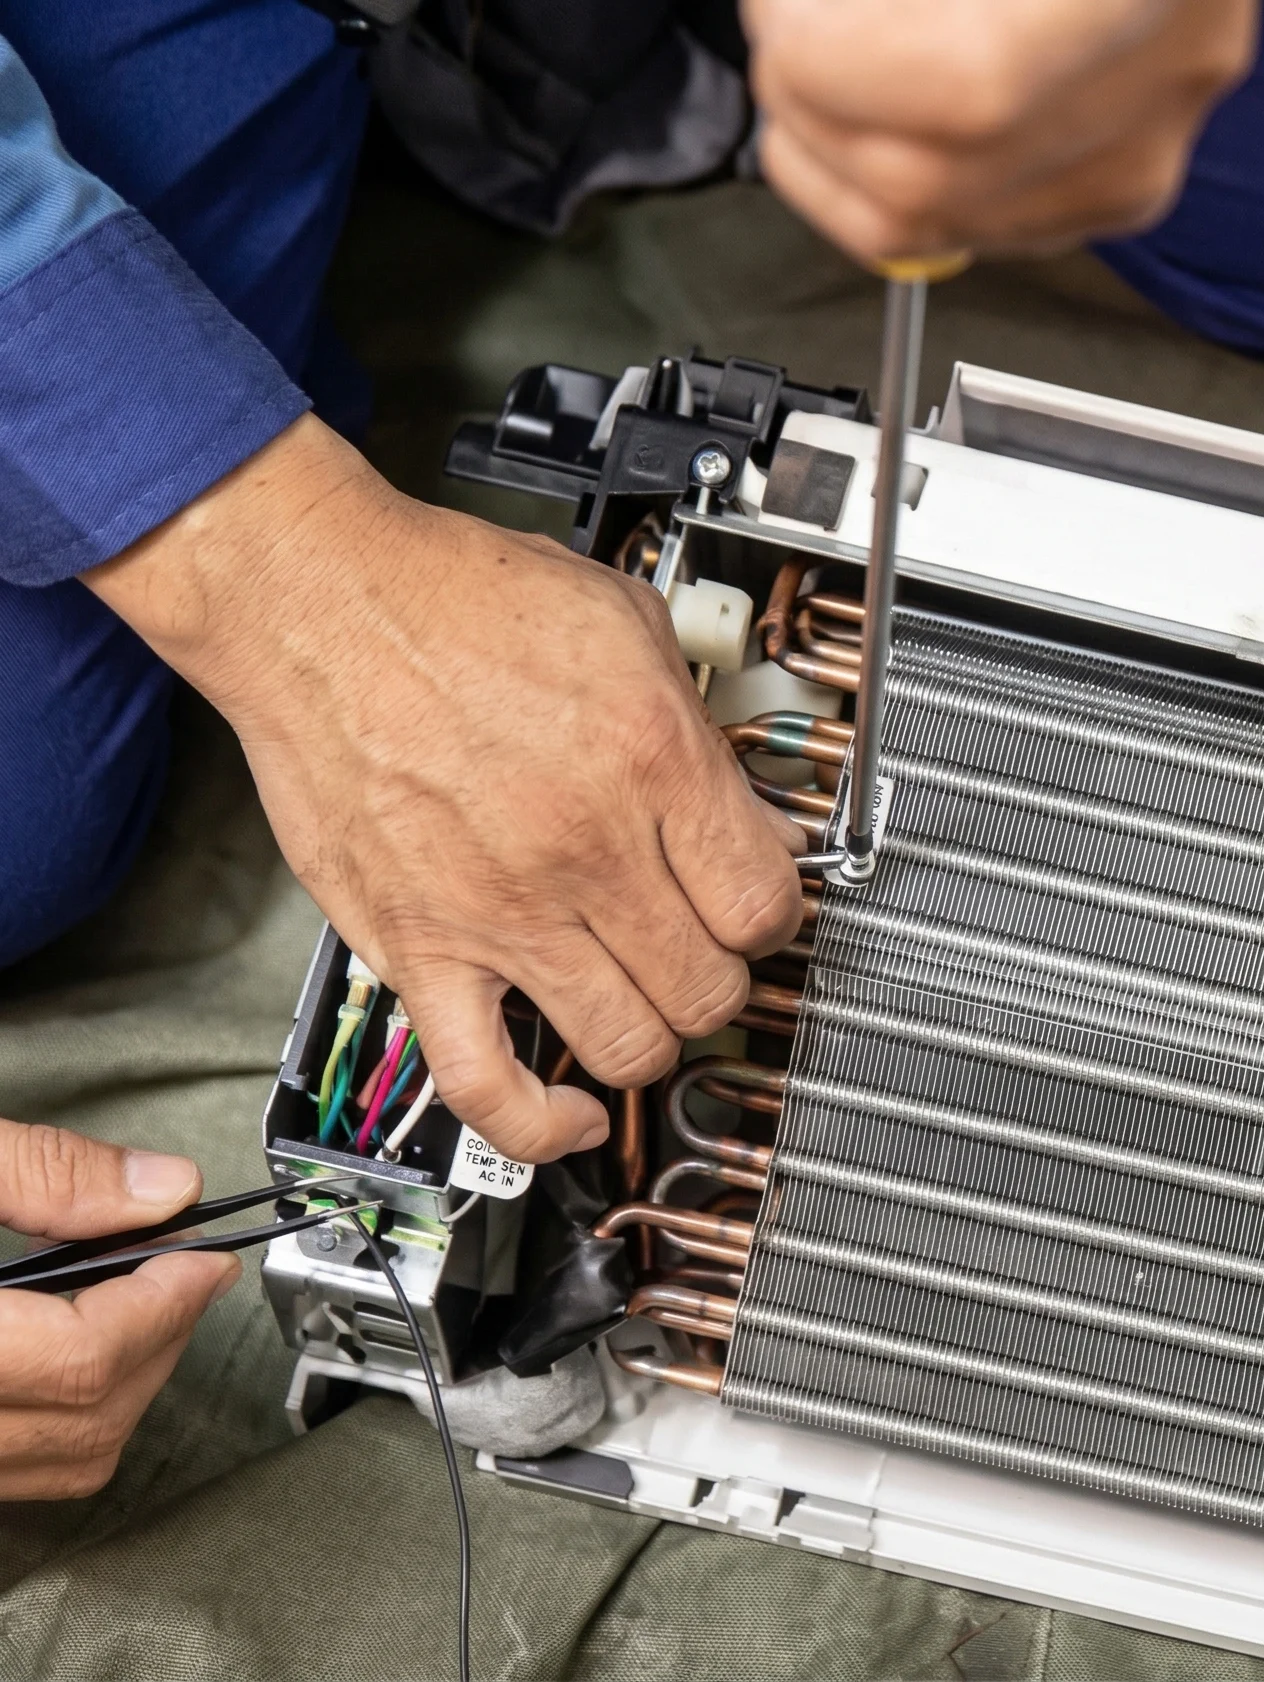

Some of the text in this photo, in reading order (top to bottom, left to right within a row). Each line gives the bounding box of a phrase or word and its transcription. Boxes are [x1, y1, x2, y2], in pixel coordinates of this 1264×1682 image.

[465, 1151, 526, 1176] TEMP SEN
[479, 1170, 514, 1187] AC IN
